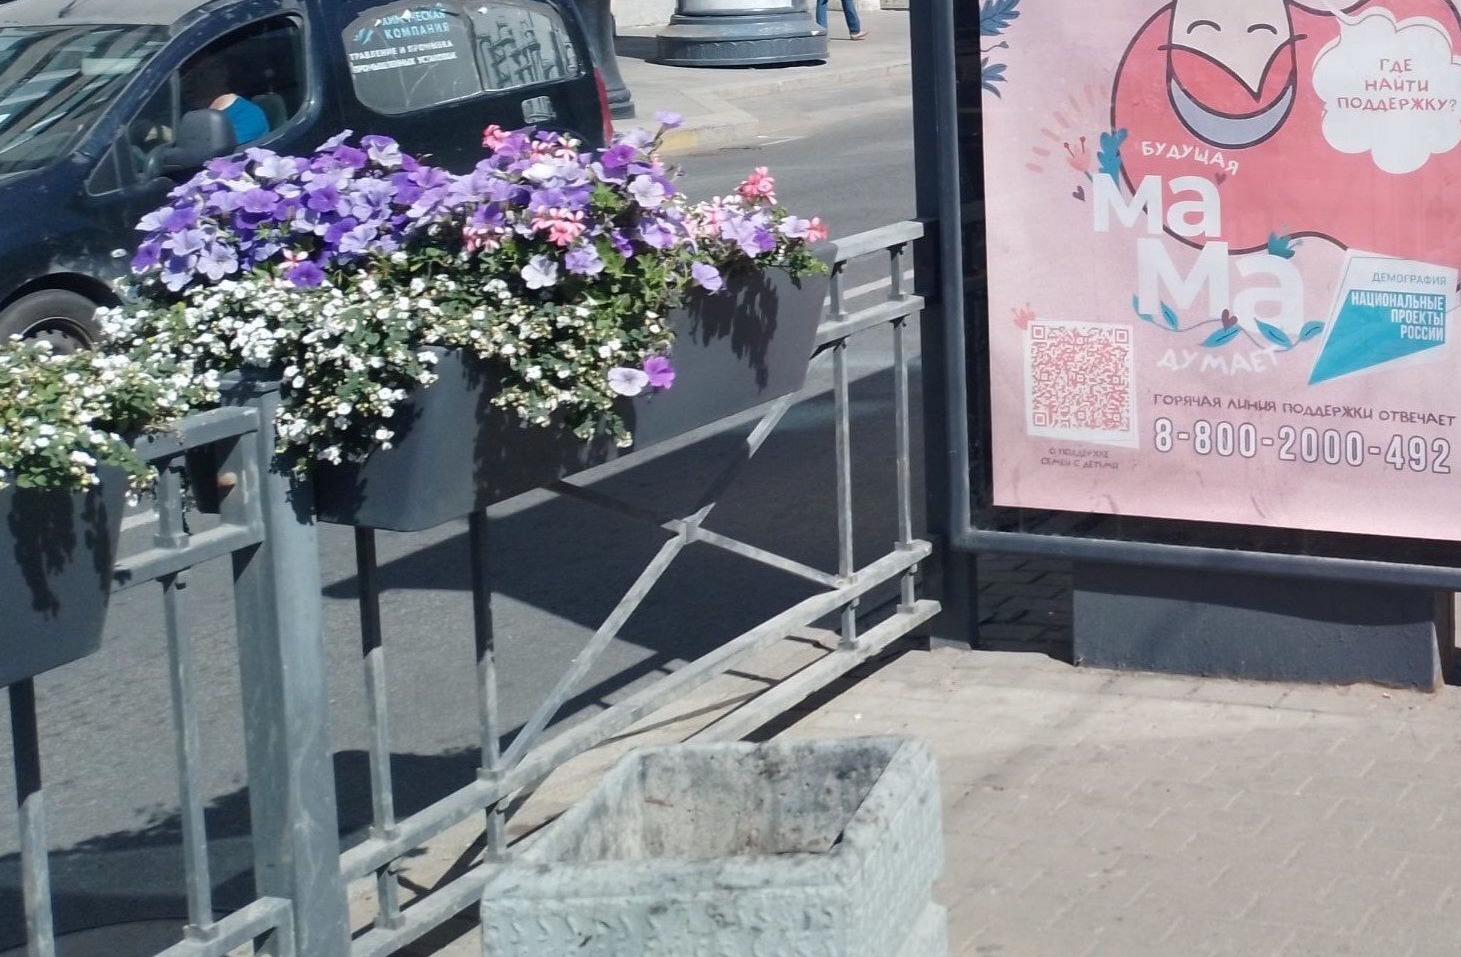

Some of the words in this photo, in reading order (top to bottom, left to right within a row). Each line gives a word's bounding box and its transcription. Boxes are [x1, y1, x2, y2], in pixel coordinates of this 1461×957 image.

[384, 22, 450, 39] КОМПАНИЯ
[1380, 58, 1412, 73] ГДЕ
[1365, 78, 1429, 92] НАЙТИ
[1337, 97, 1457, 111] ПОДДЕРЖКУ?
[1141, 141, 1239, 175] БУДУЩАЯ
[1372, 272, 1447, 286] ДЕМОГРАФИЯ
[1352, 291, 1444, 311] НАЦИОНАЛЬНЫЕ
[1391, 309, 1444, 326] ПРОЕКТЫ
[1400, 325, 1444, 341] РОССИИ
[1156, 347, 1279, 376] ДУМАЕТ
[1153, 394, 1222, 408] ГОРЯЧАЯ
[1228, 399, 1277, 413] ЛИНИЯ
[1283, 403, 1373, 419] ПОДДЕРЖКИ
[1379, 410, 1456, 426] ОТВЕЧАЕТ
[1154, 417, 1451, 474] 8-800-2000-492
